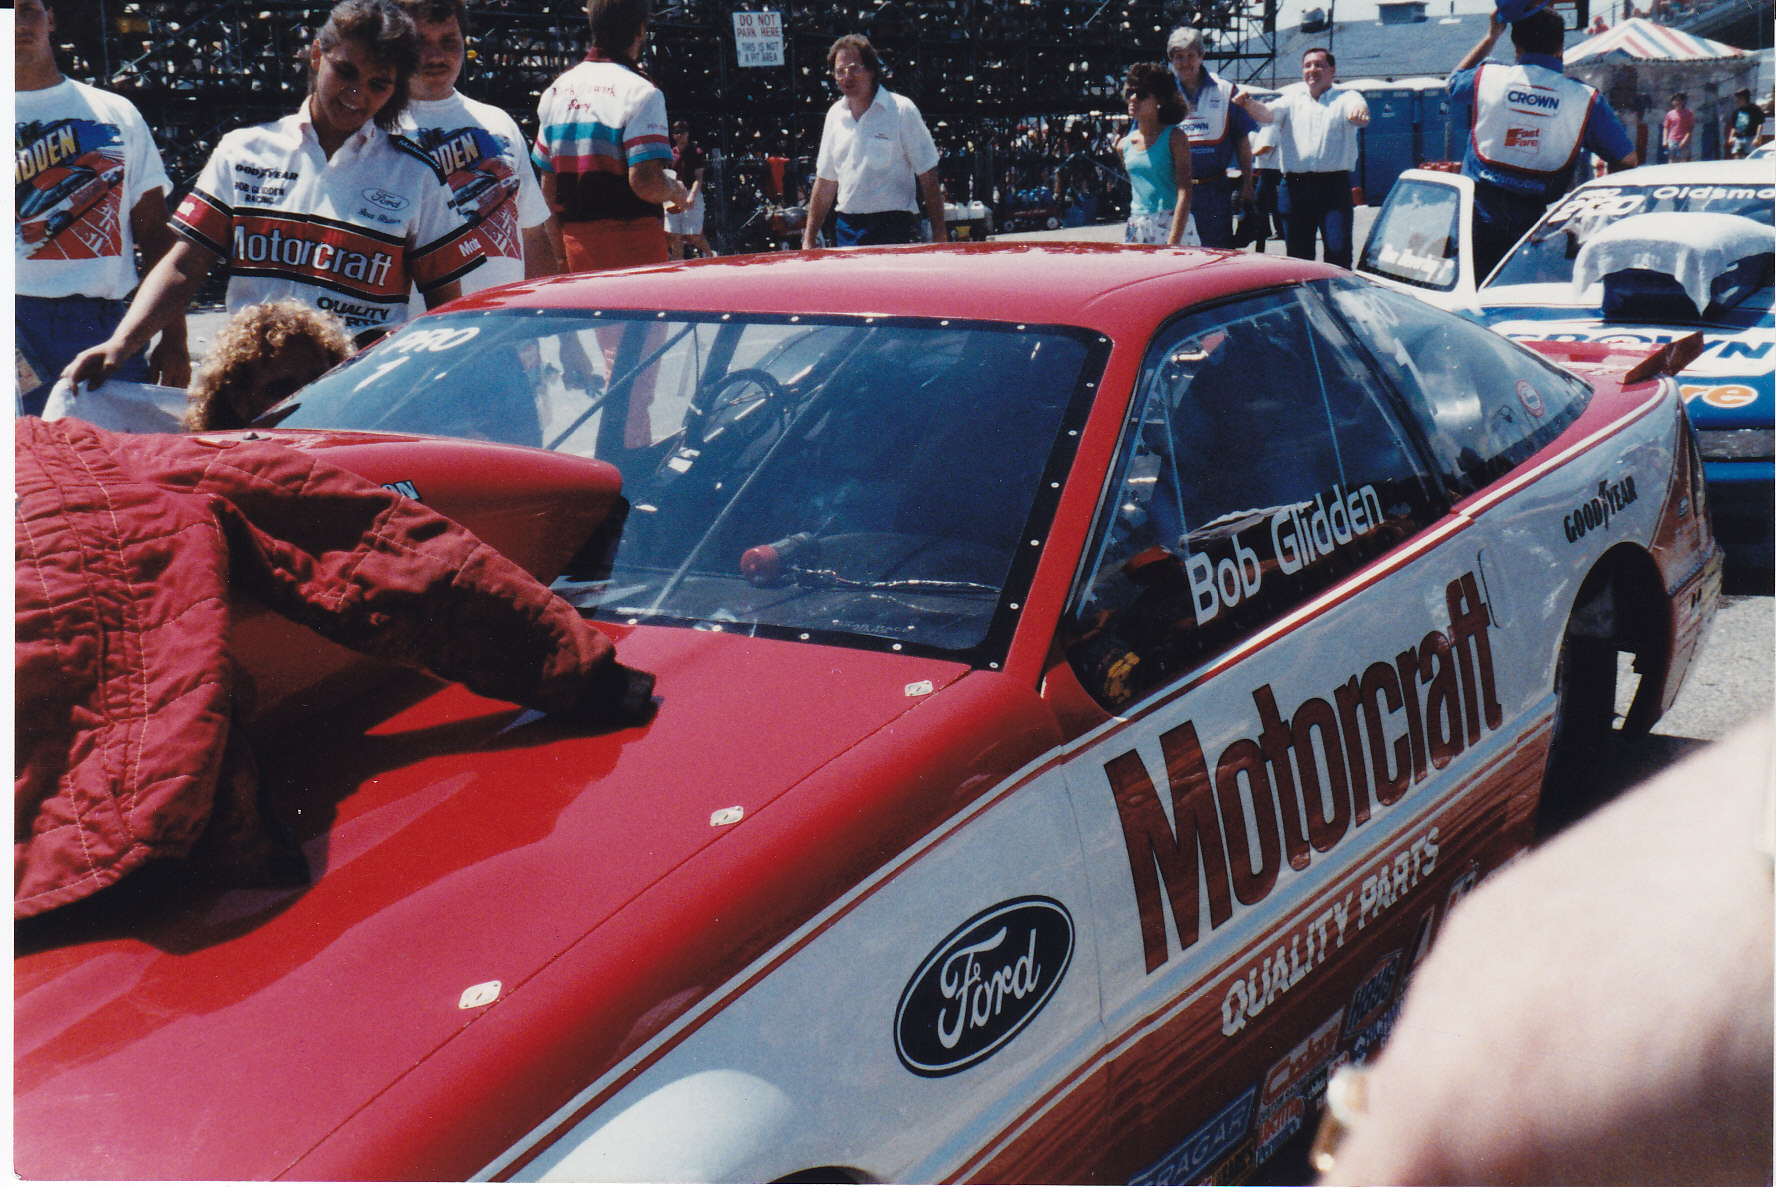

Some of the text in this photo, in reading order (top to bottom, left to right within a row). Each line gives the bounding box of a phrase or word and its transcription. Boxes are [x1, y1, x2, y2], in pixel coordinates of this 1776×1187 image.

[739, 14, 776, 26] DO NOT
[736, 26, 780, 37] PARK HERE
[766, 41, 779, 51] NOT
[1508, 90, 1560, 109] CROWN
[1505, 138, 1538, 147] Fare
[1508, 128, 1541, 138] Fast
[235, 163, 298, 181] OODYEAR
[245, 193, 274, 205] RACING
[251, 185, 285, 196] GLIDDEN
[371, 191, 402, 209] Ford
[232, 225, 393, 287] Motorcraft
[317, 297, 390, 320] QUALITY
[380, 327, 481, 356] PRO
[1564, 475, 1638, 543] GOODYEAR
[1184, 483, 1384, 627] Bob Glidden
[1103, 571, 1503, 975] Motorcraft
[1221, 889, 1354, 1037] QUALITY
[1357, 826, 1440, 931] PARTS
[937, 926, 1041, 1049] Ford
[1145, 1104, 1246, 1186] RAGAR
